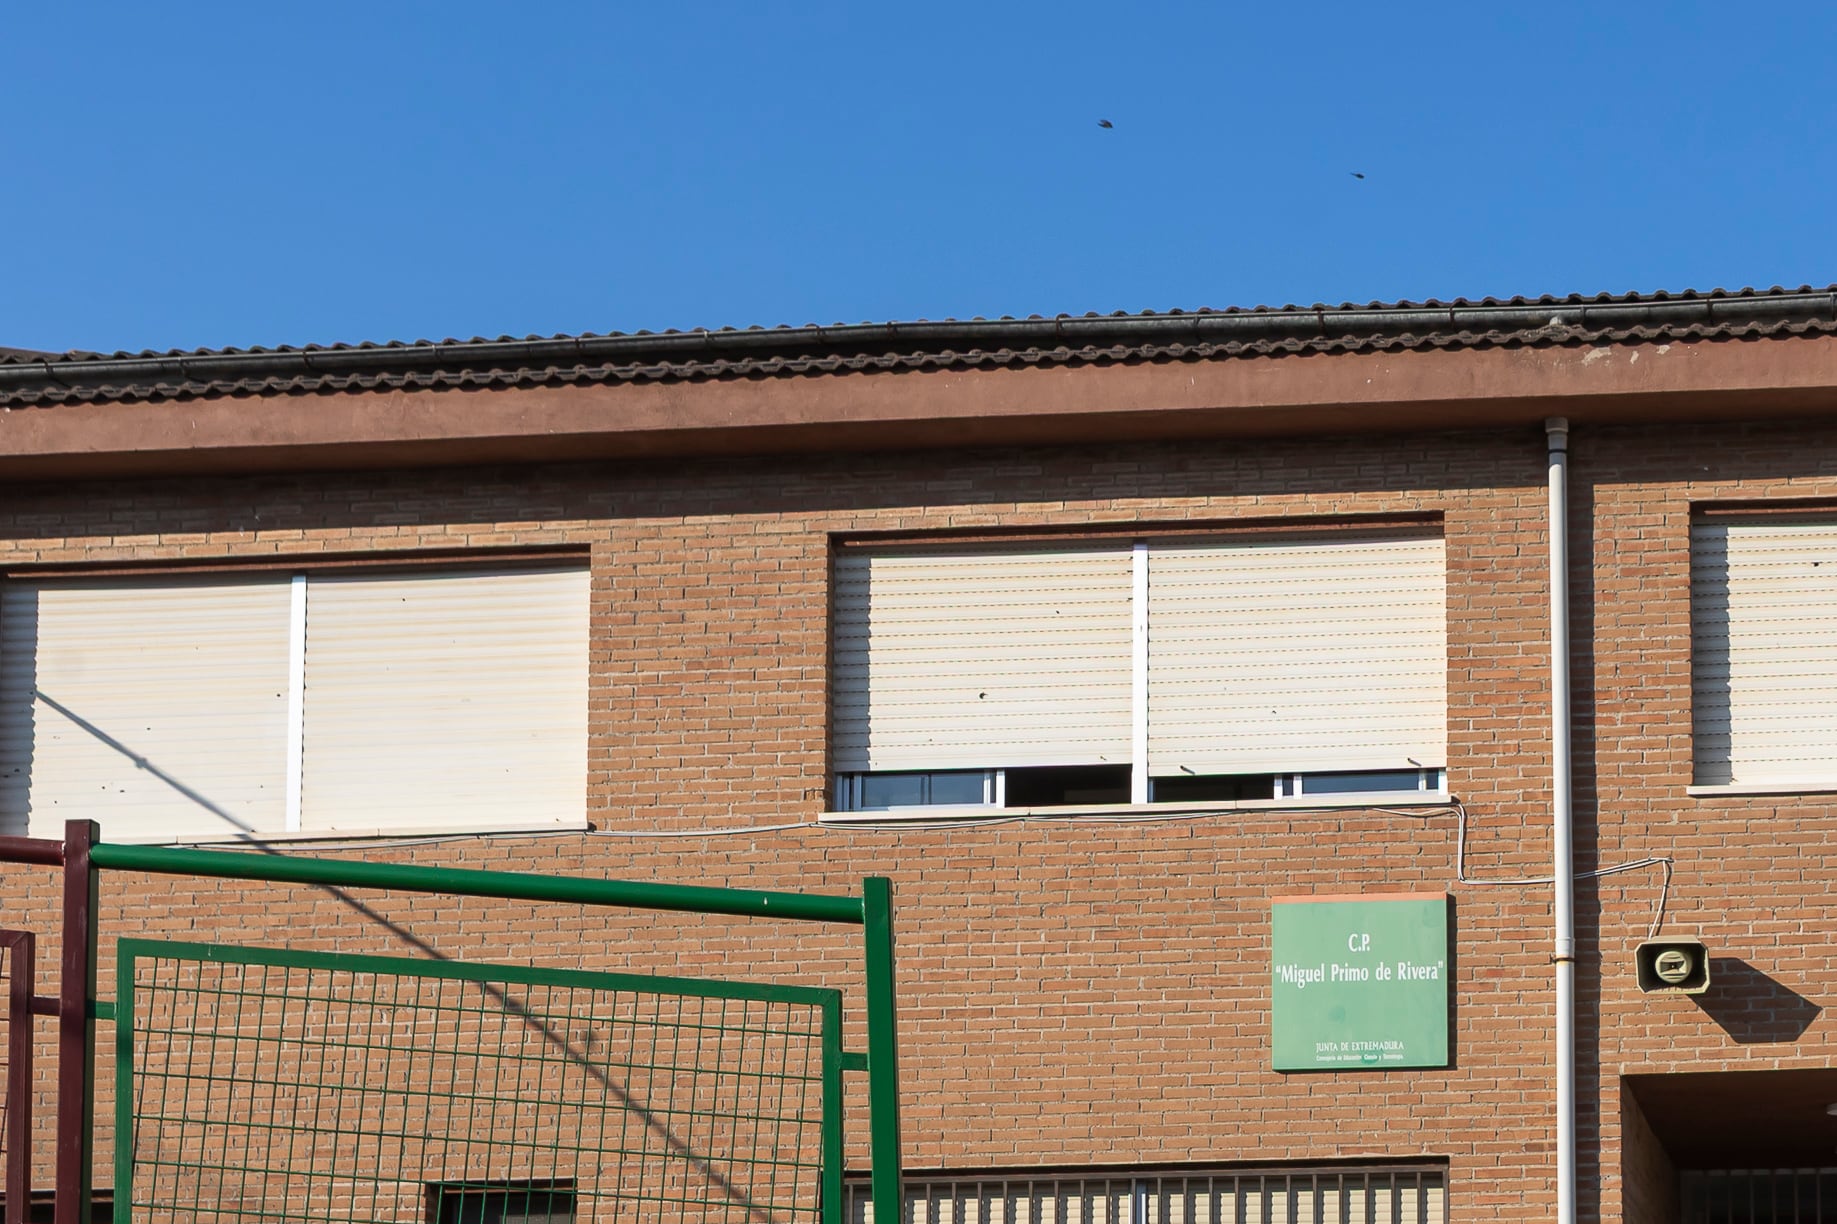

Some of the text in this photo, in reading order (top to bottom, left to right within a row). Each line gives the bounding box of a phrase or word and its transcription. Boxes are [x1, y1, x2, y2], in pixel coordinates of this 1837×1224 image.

[1348, 933, 1371, 952] C.P.
[1331, 964, 1369, 981] Primo
[1376, 961, 1391, 980] de
[1316, 1041, 1404, 1053] JUNTA DE EXTREMADURA
